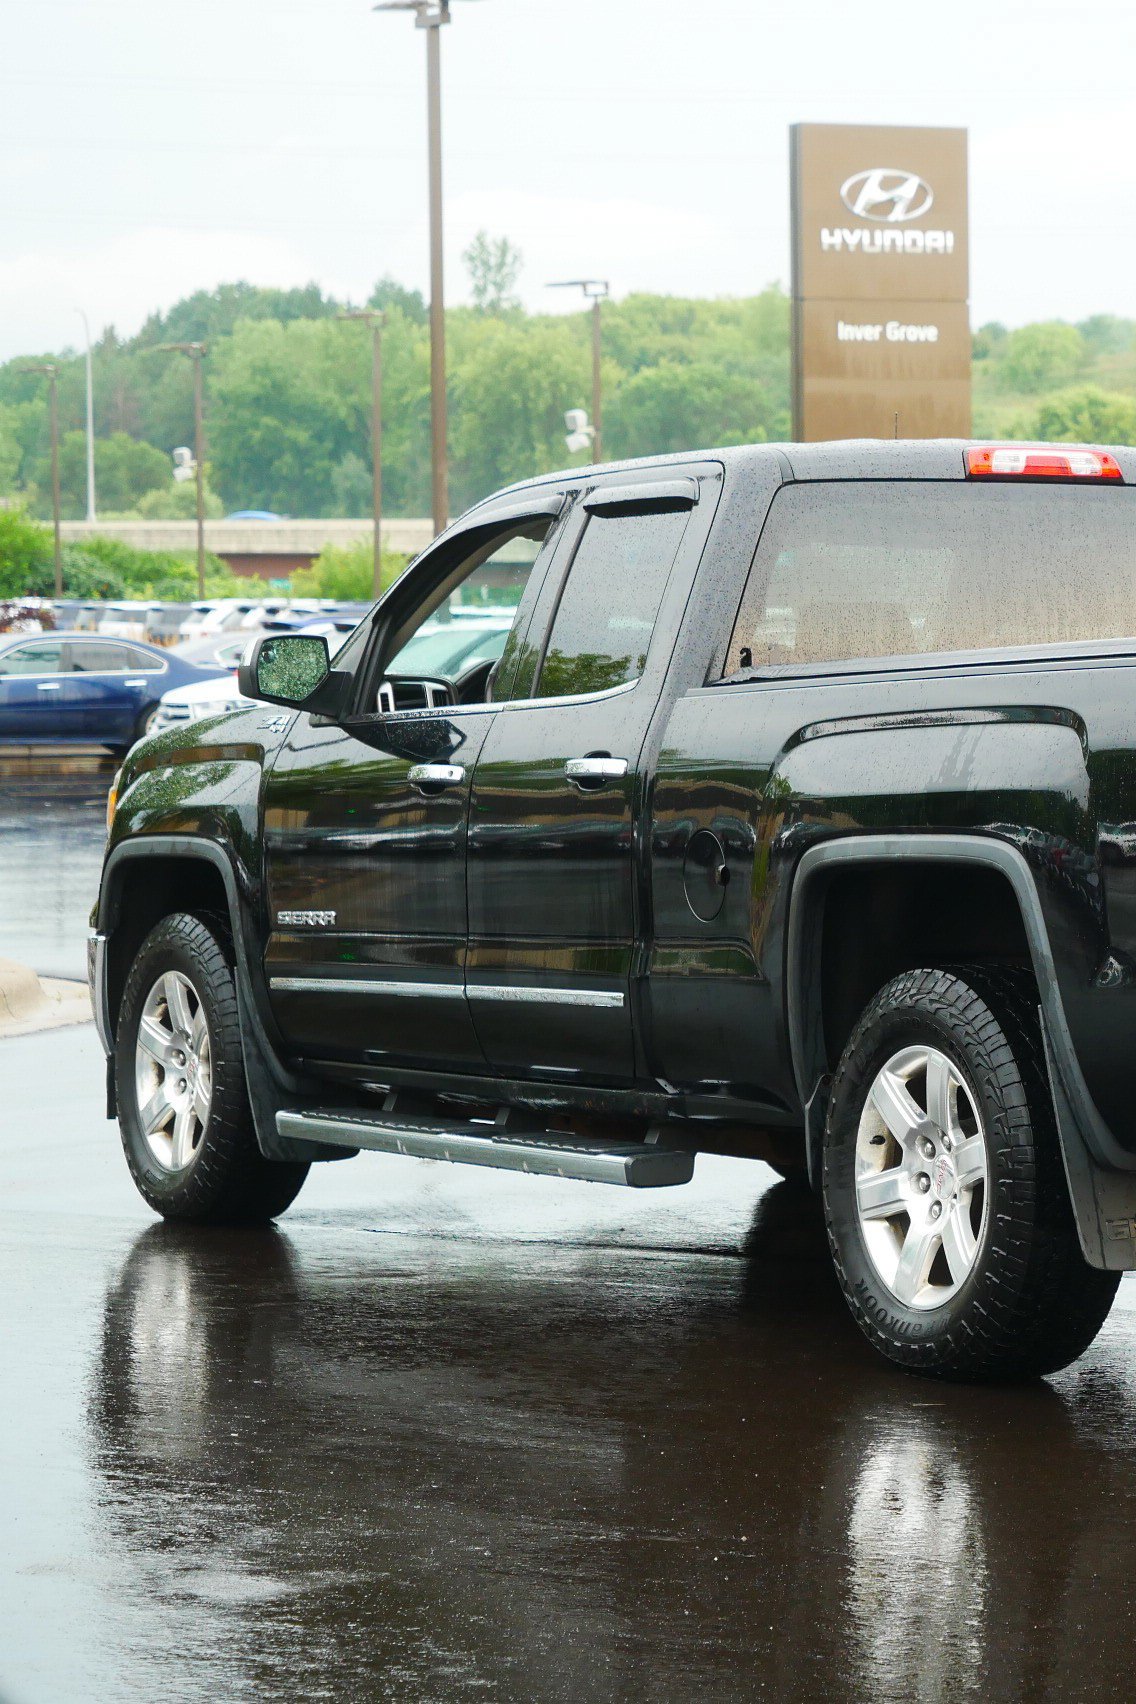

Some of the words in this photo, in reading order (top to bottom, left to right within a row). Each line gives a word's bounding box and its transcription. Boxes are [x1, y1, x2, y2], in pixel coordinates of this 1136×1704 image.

[821, 228, 954, 254] HYUNDAI
[837, 321, 883, 341] Inver
[885, 321, 939, 342] Grove
[277, 910, 336, 926] SIERRA
